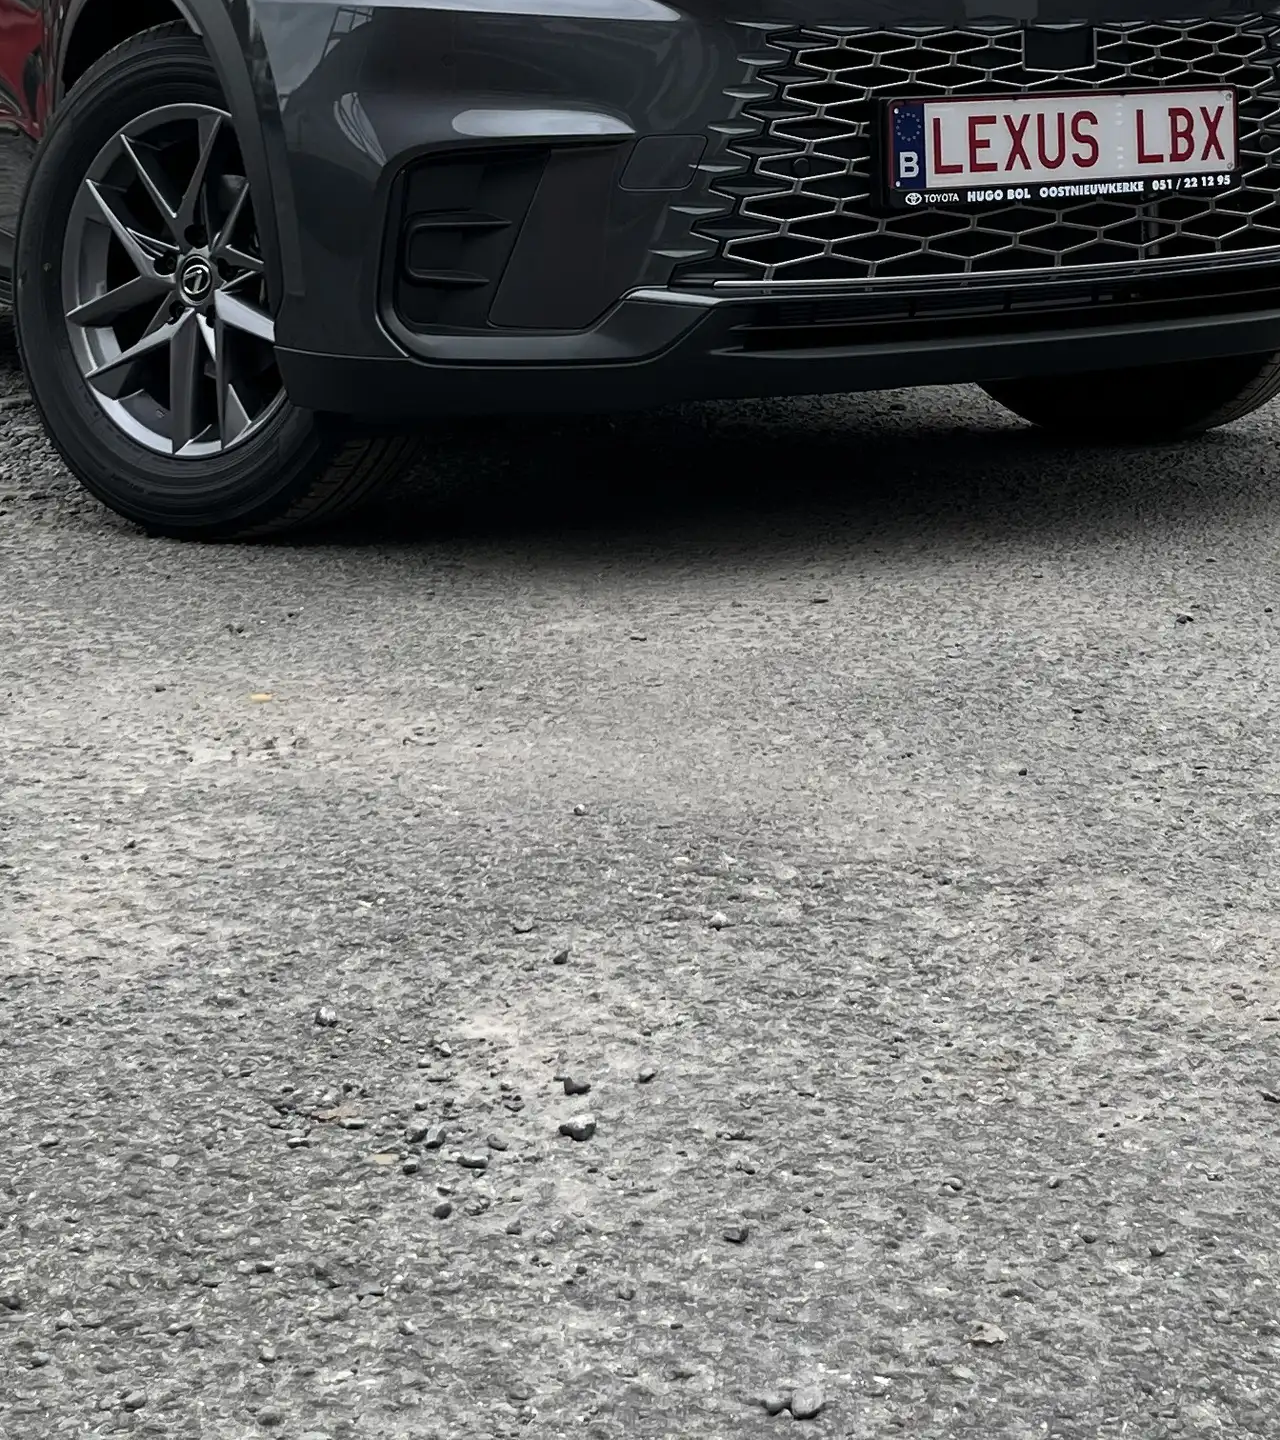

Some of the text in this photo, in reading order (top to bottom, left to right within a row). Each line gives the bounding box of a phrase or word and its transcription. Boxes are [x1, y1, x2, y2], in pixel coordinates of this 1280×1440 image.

[933, 105, 1225, 174] LEXUS LBX
[899, 151, 919, 178] B
[924, 192, 960, 203] TOYOTA
[967, 189, 1003, 202] HUGO
[1007, 187, 1031, 200] BOL
[1039, 181, 1145, 198] OOSTNIEUWKERKE
[1152, 179, 1172, 191] 051
[1184, 177, 1198, 189] 22
[1202, 176, 1214, 187] 12
[1217, 175, 1231, 186] 95
